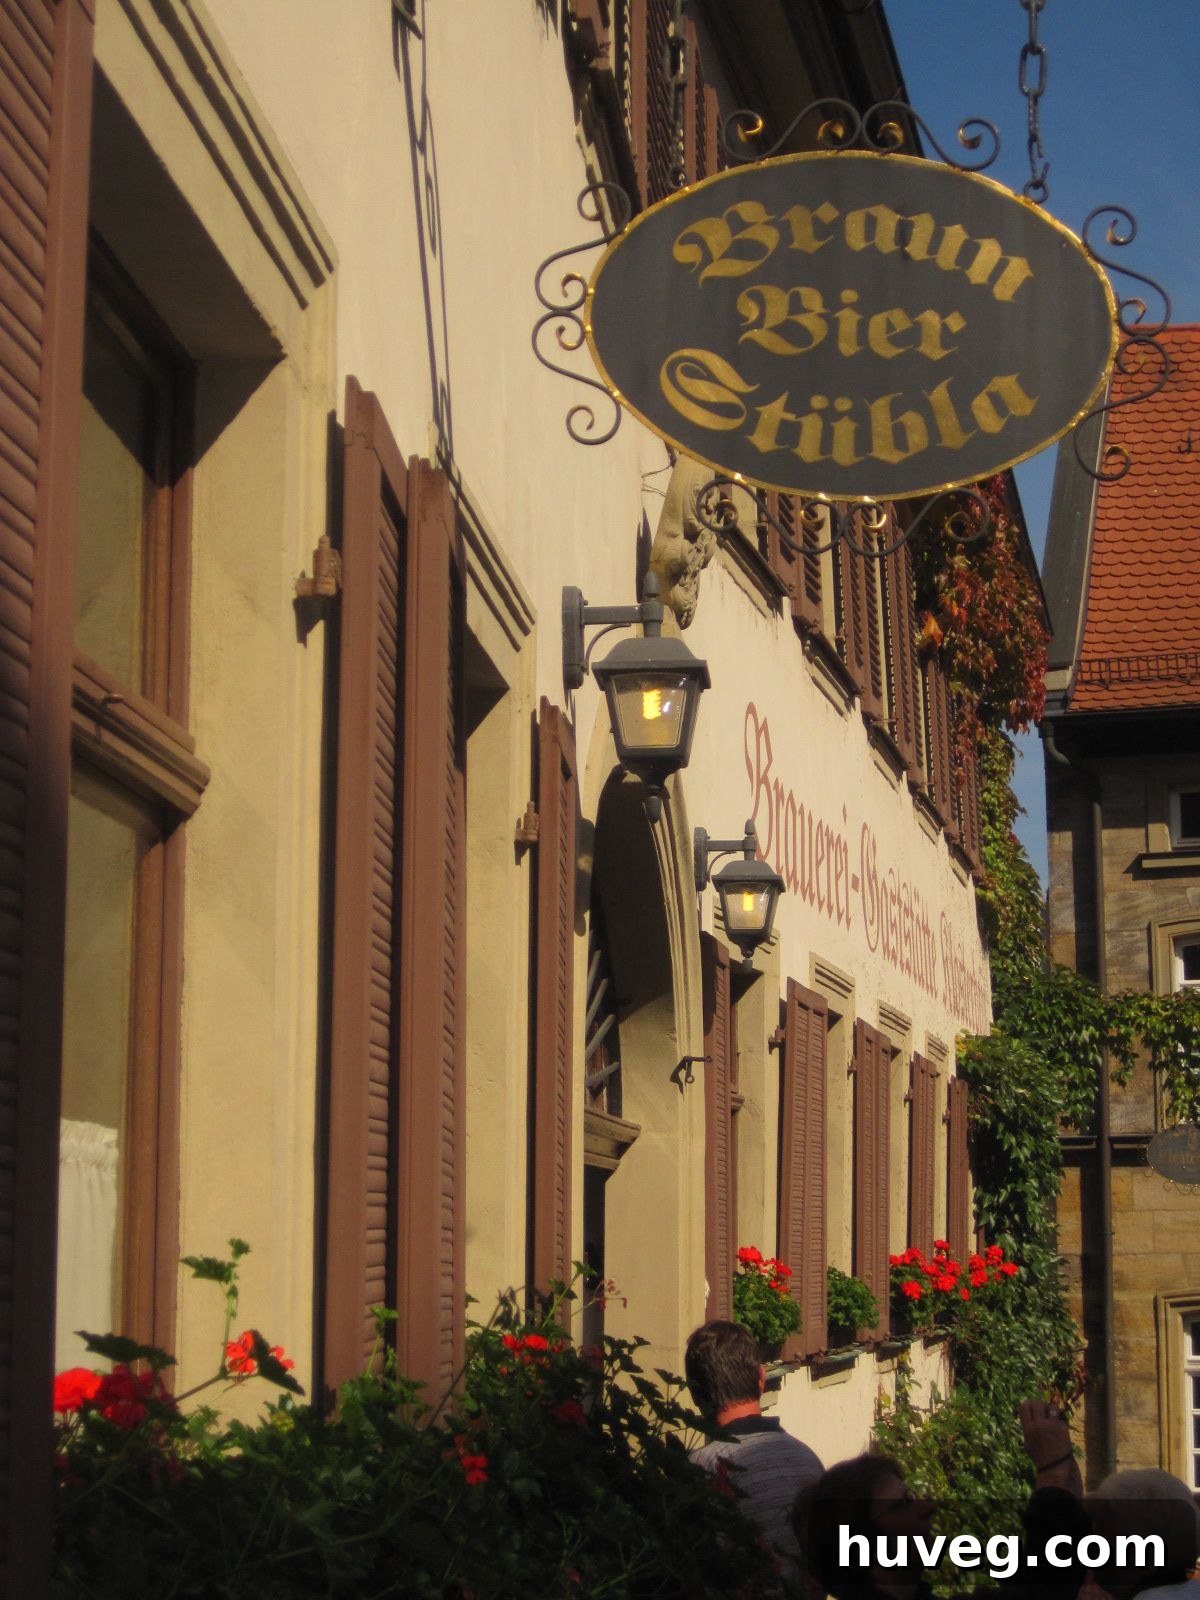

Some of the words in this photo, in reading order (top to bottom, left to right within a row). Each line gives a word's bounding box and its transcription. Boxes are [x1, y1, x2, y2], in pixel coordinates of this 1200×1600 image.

[672, 200, 1036, 301] Braun
[736, 284, 967, 361] Bier
[659, 348, 1040, 467] Stübla
